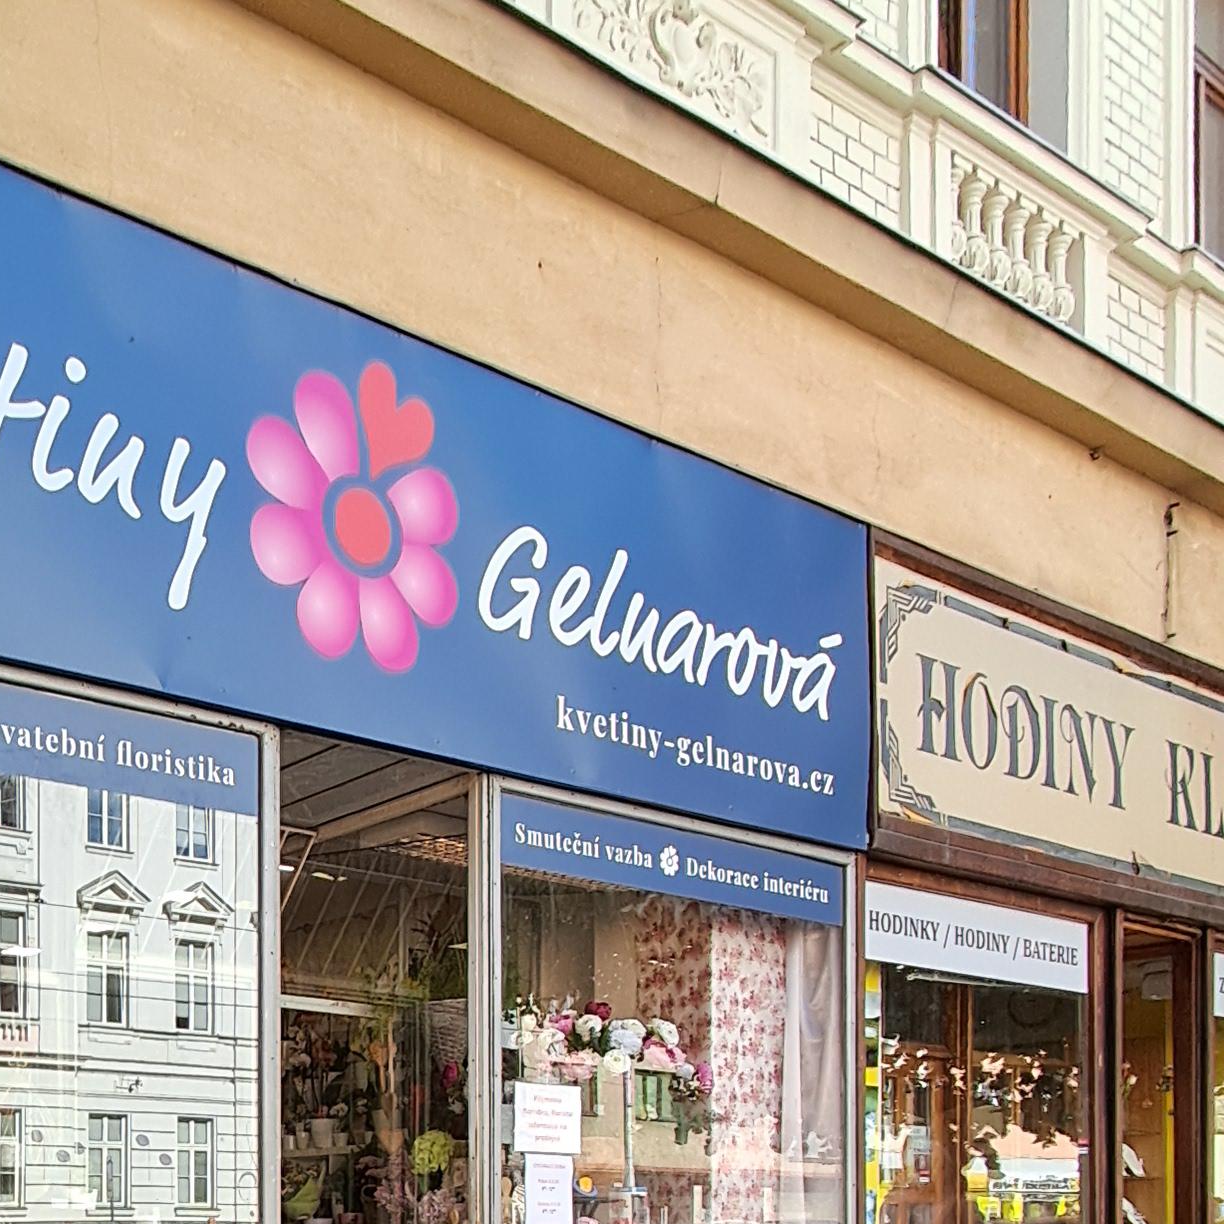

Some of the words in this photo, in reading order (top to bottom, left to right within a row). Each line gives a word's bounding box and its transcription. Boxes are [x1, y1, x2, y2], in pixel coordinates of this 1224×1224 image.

[478, 525, 843, 721] Gelnarová
[116, 740, 237, 787] floristika
[556, 695, 835, 796] kvetiny-gelnarova.cz
[915, 652, 1136, 810] HODINY
[514, 822, 601, 859] Smuteční
[605, 845, 653, 869] vazba
[686, 857, 760, 889] Dekorace
[764, 872, 830, 904] interiéru
[869, 910, 940, 942] HODINKY
[954, 925, 1011, 954] HODINY
[1023, 936, 1079, 967] BATERIE
